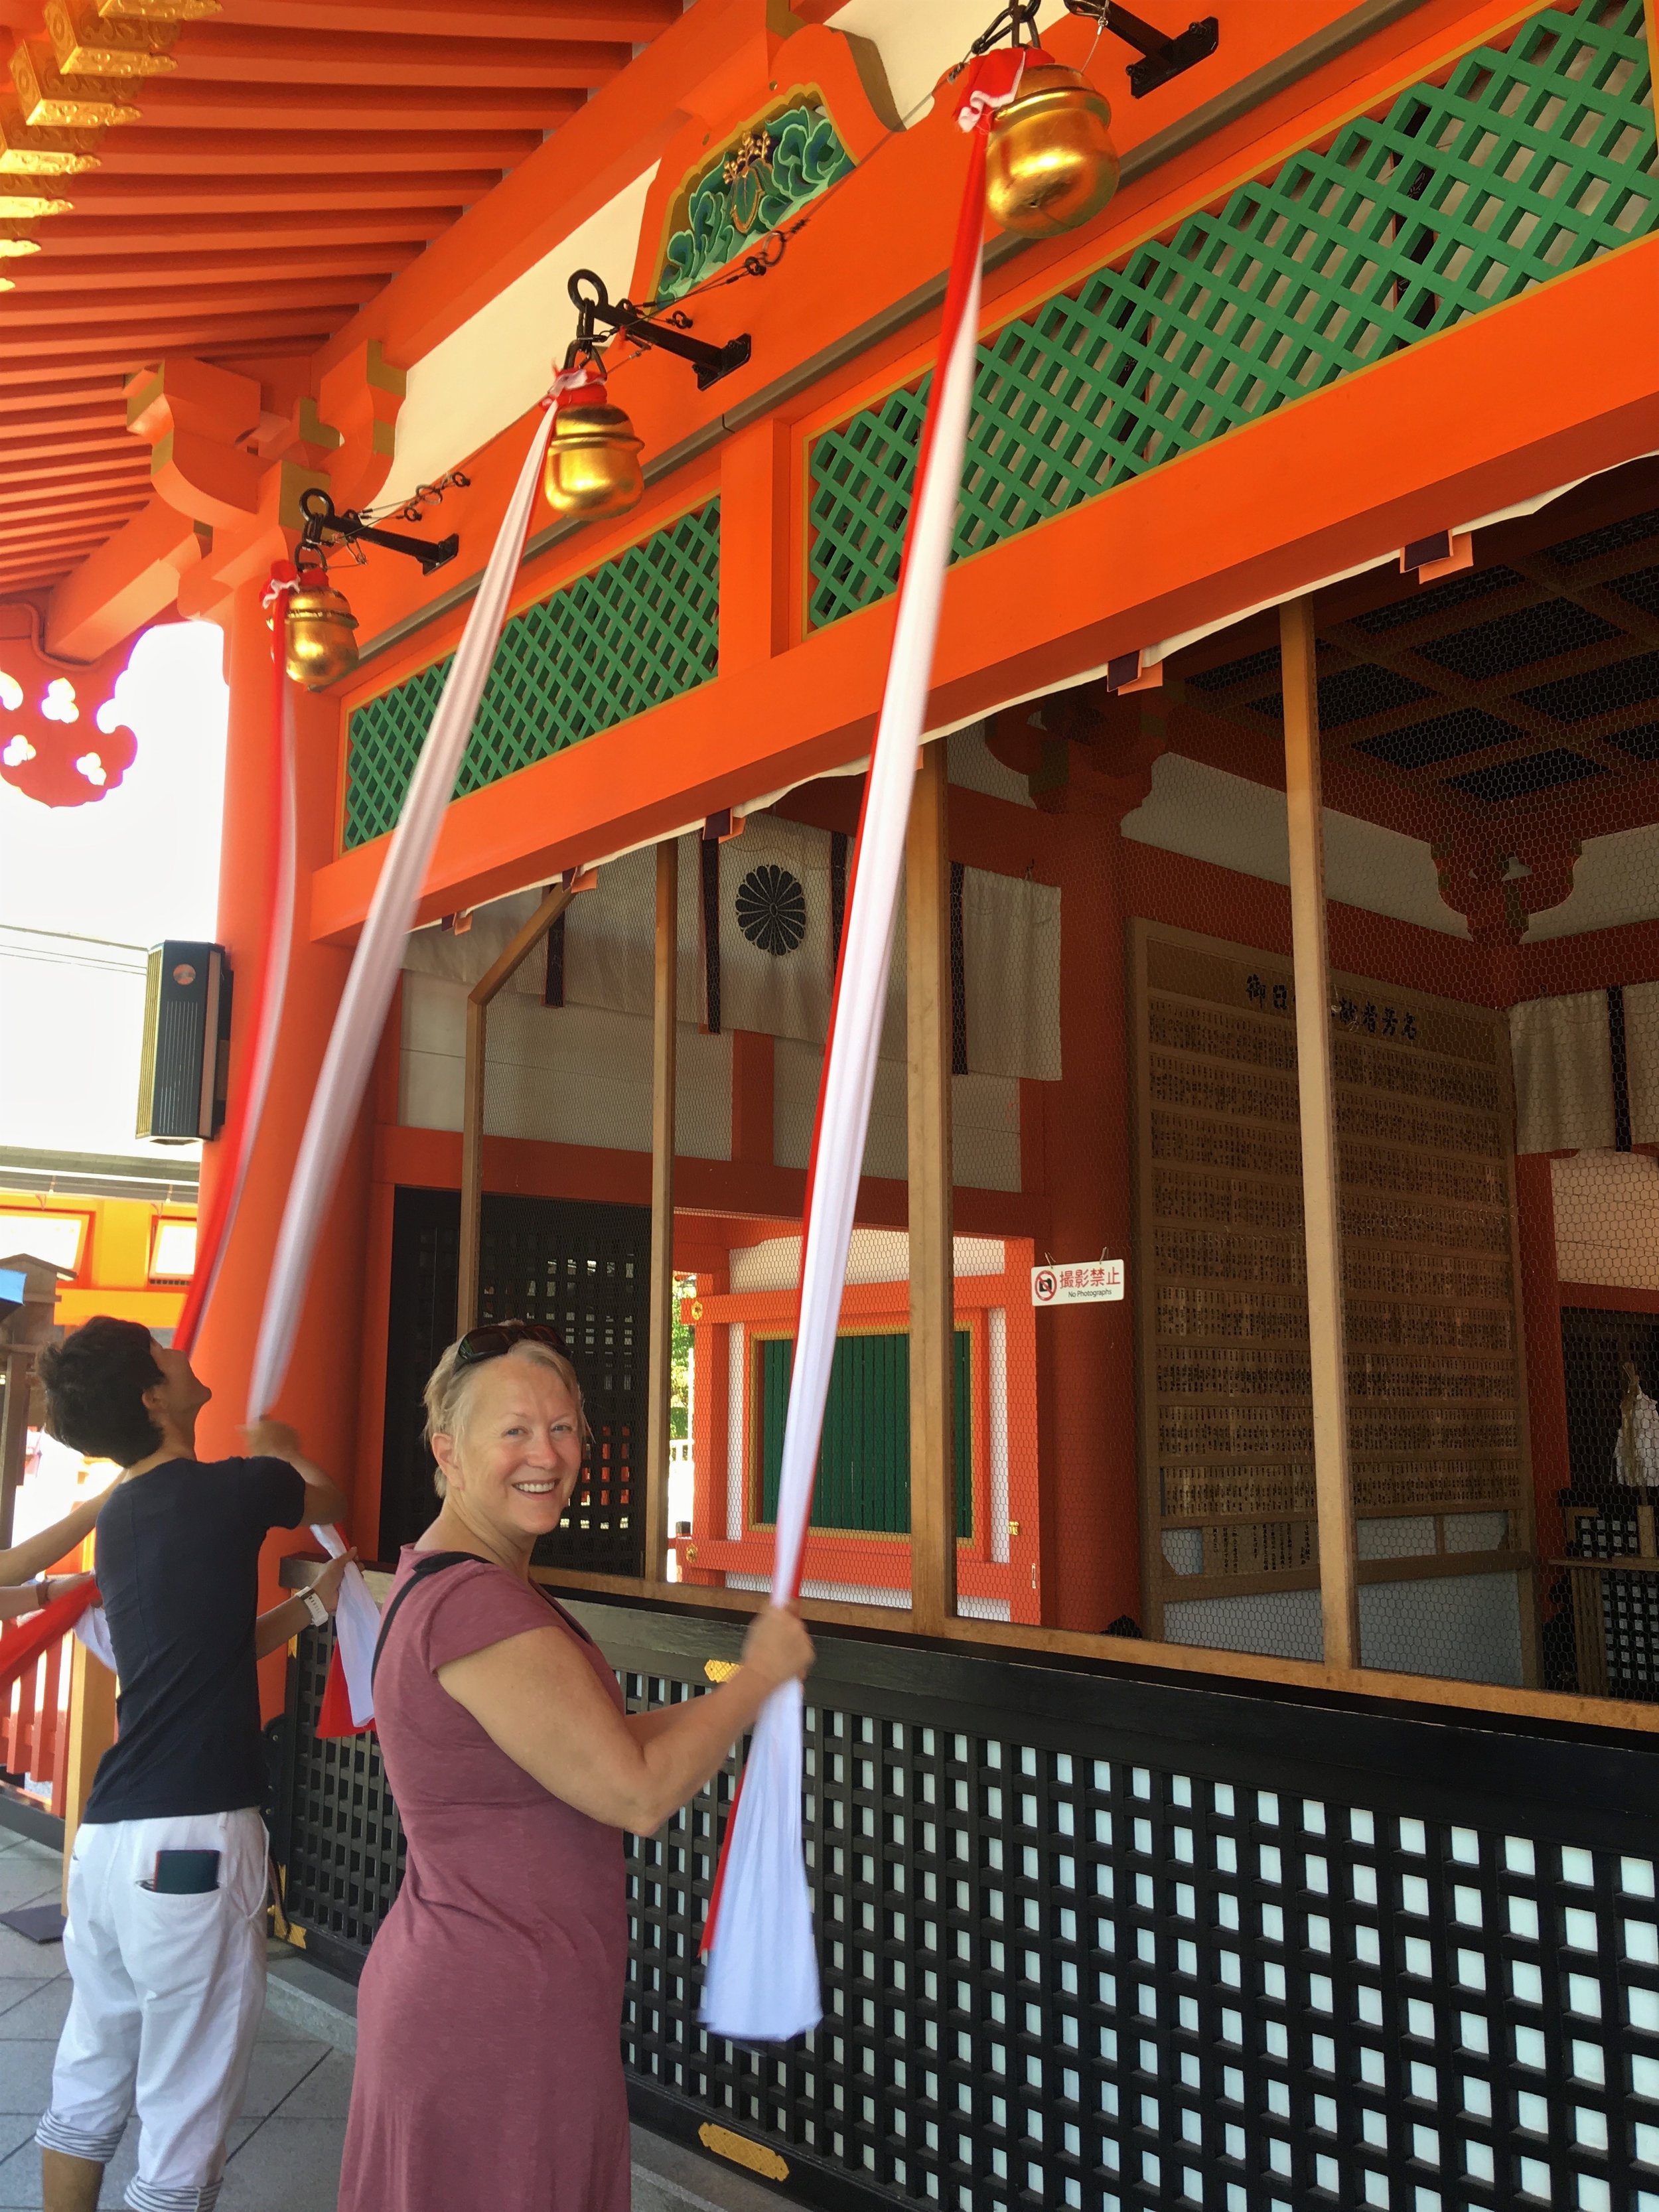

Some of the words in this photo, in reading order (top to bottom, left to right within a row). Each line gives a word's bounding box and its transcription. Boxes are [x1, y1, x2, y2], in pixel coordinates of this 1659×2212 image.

[1060, 1266, 1121, 1289] 撮影禁止
[1077, 1288, 1112, 1297] Photographs
